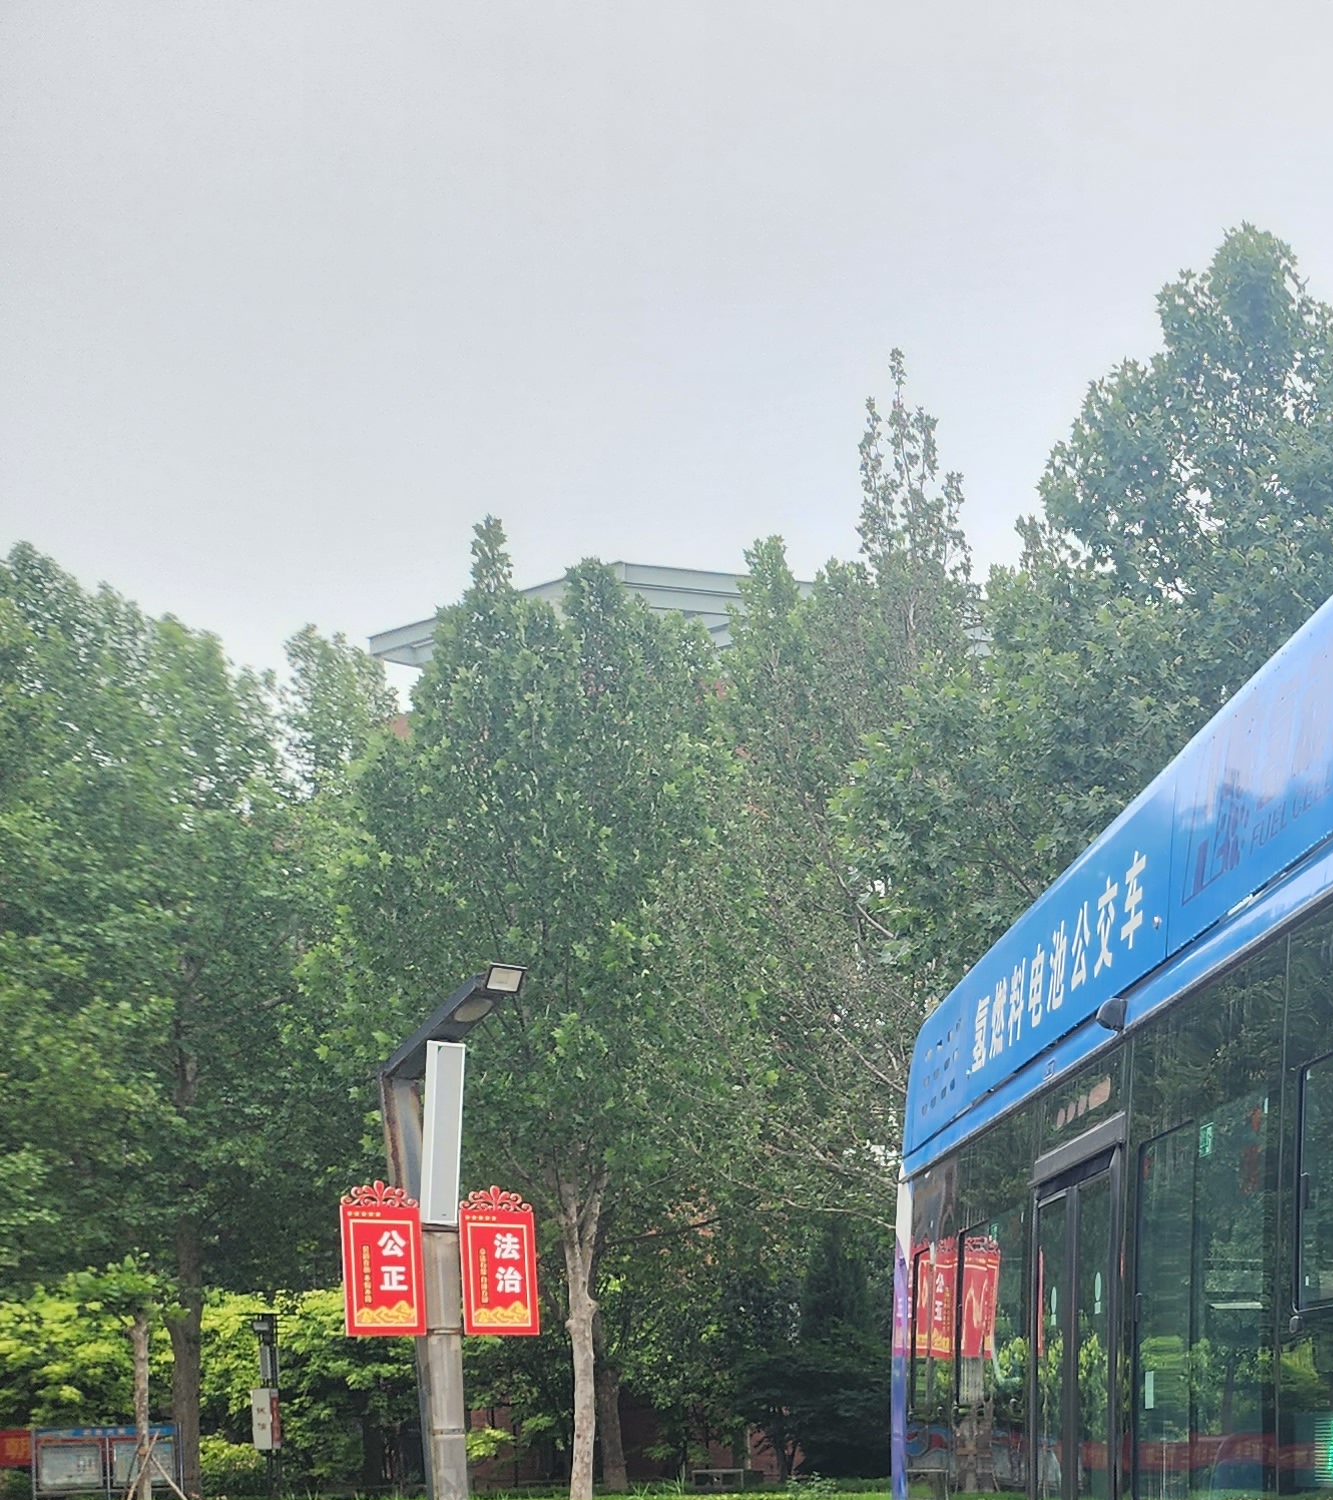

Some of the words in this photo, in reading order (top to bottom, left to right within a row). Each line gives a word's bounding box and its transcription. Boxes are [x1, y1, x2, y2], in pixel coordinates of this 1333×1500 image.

[971, 850, 1147, 1073] 氢燃料电池公交车
[378, 1230, 408, 1291] 公正
[494, 1233, 523, 1294] 法治
